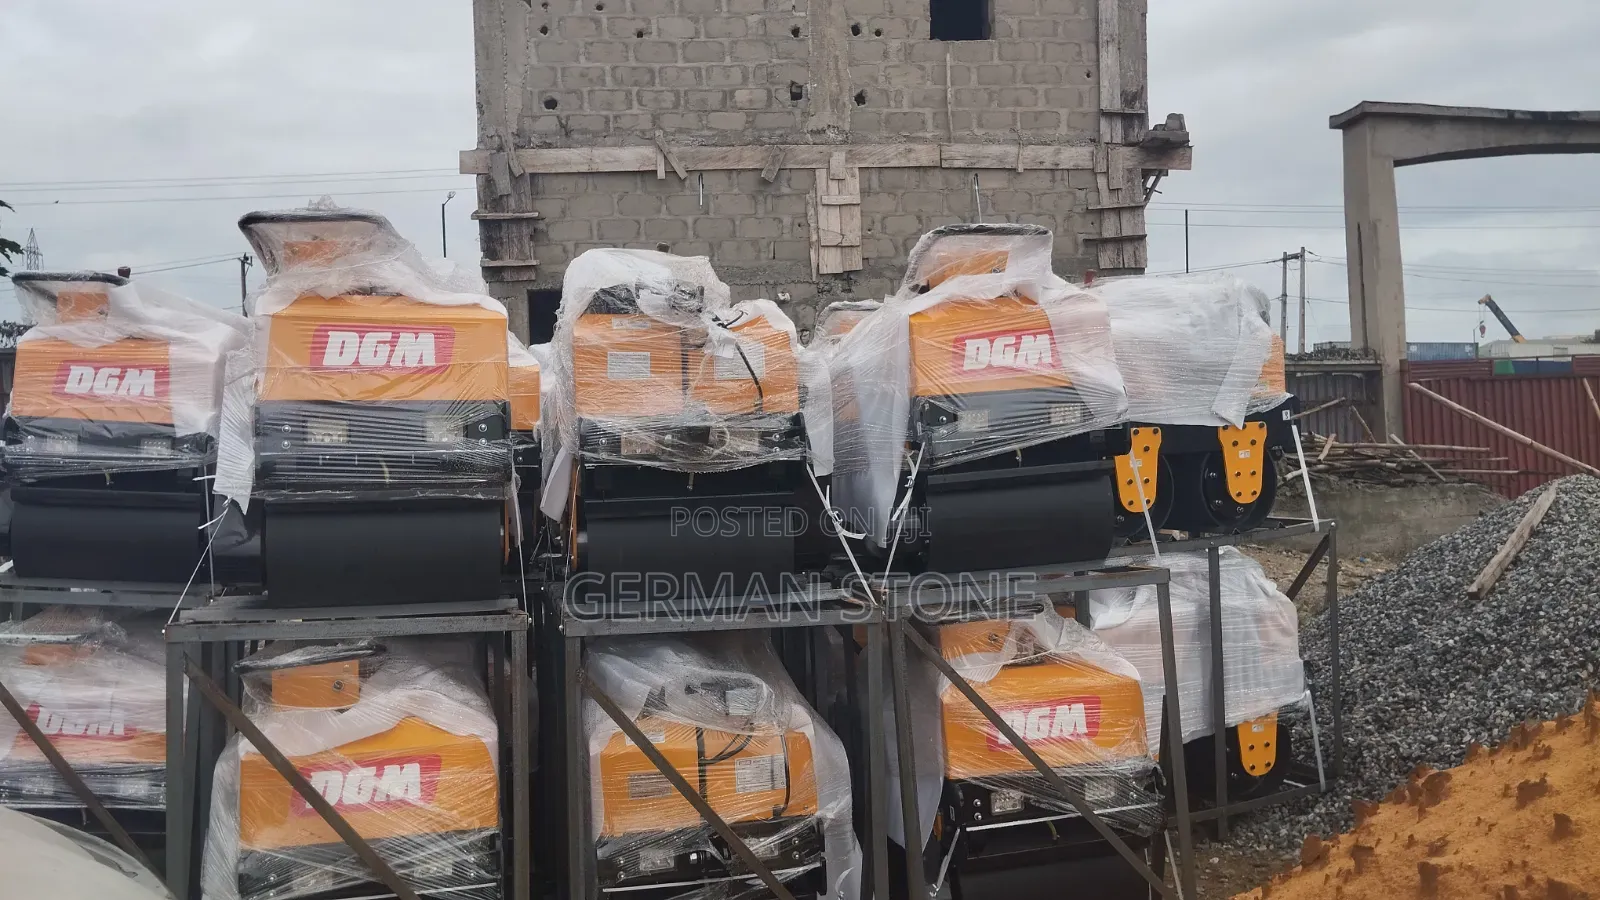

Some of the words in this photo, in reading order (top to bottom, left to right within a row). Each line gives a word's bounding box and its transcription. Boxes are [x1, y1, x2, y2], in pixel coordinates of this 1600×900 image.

[322, 331, 436, 367] DGM
[963, 333, 1053, 371] DGM
[64, 365, 156, 397] DGM
[998, 703, 1088, 744] DGM
[305, 763, 421, 808] DGM
